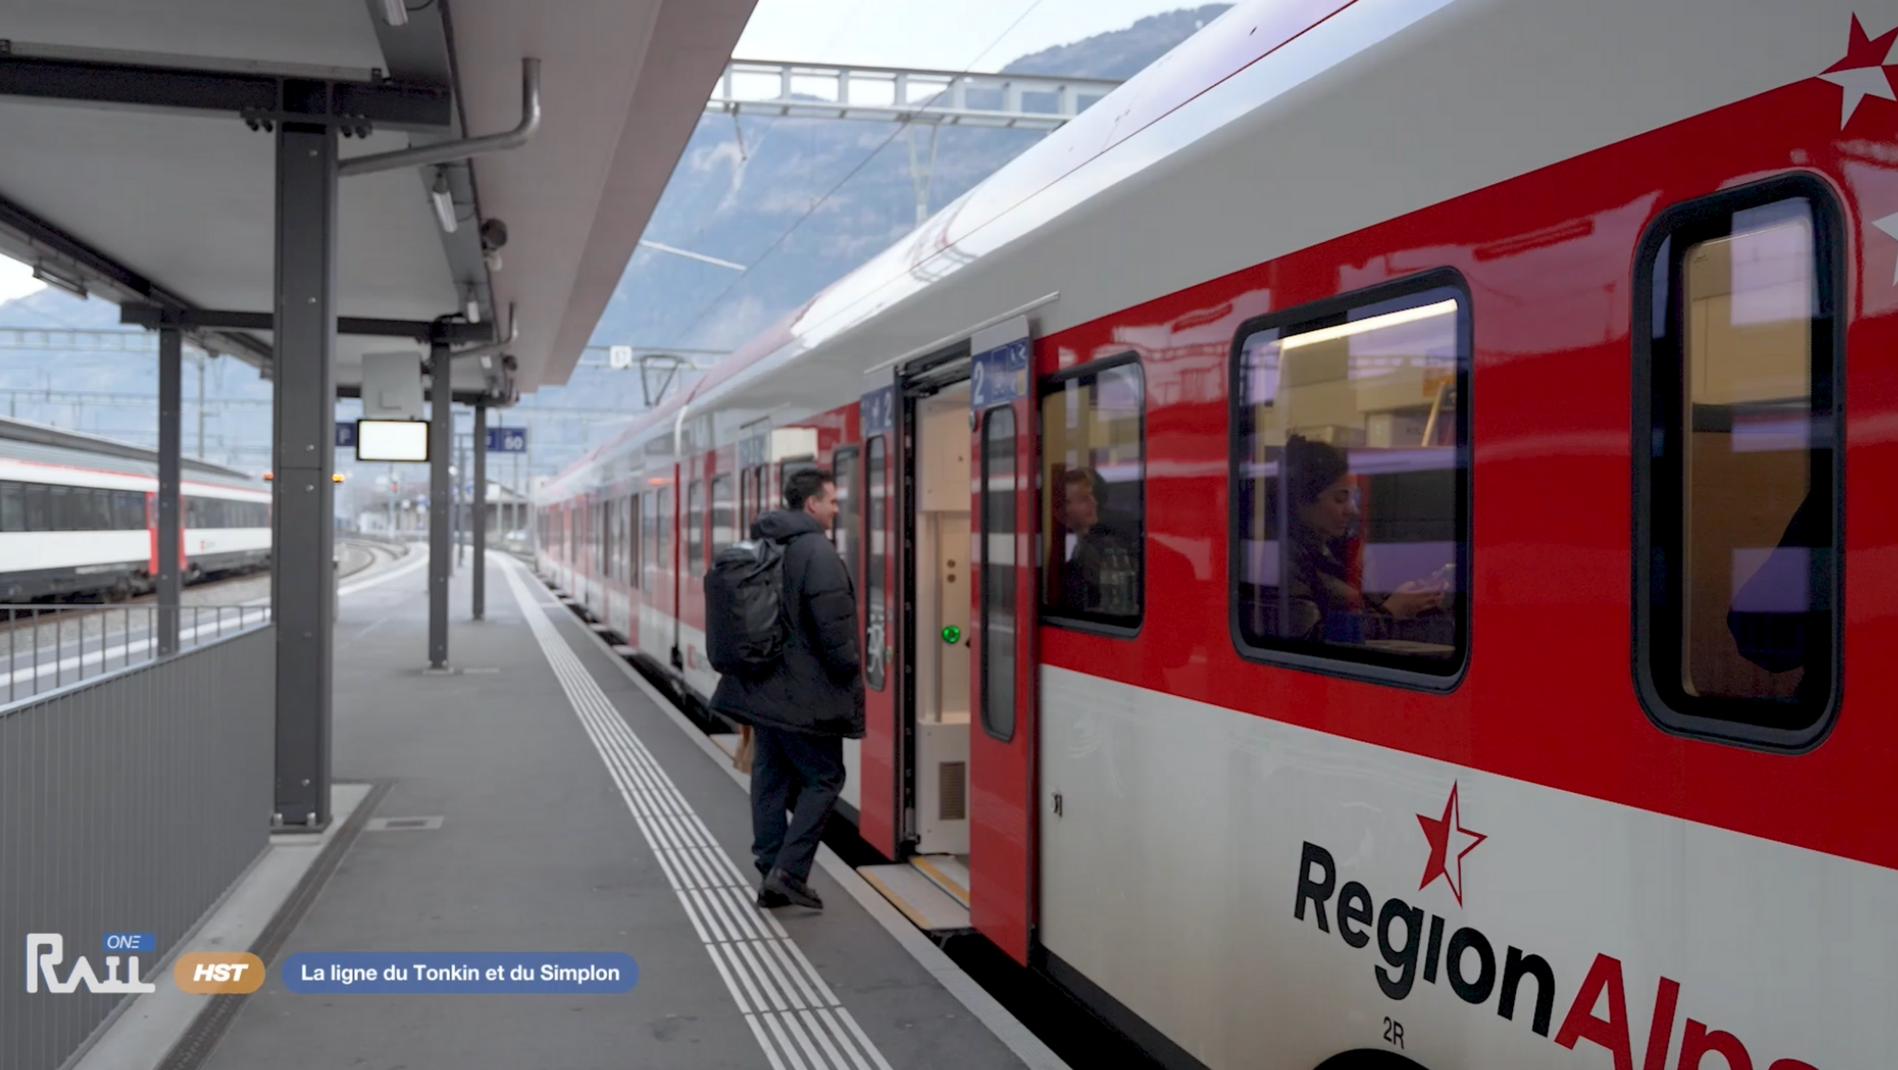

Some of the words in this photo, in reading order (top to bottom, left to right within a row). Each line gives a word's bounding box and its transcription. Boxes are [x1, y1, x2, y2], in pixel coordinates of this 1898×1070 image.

[973, 361, 985, 405] 2
[883, 391, 892, 427] 2
[1294, 840, 1821, 1070] RegionAl
[1383, 1016, 1405, 1050] 2R
